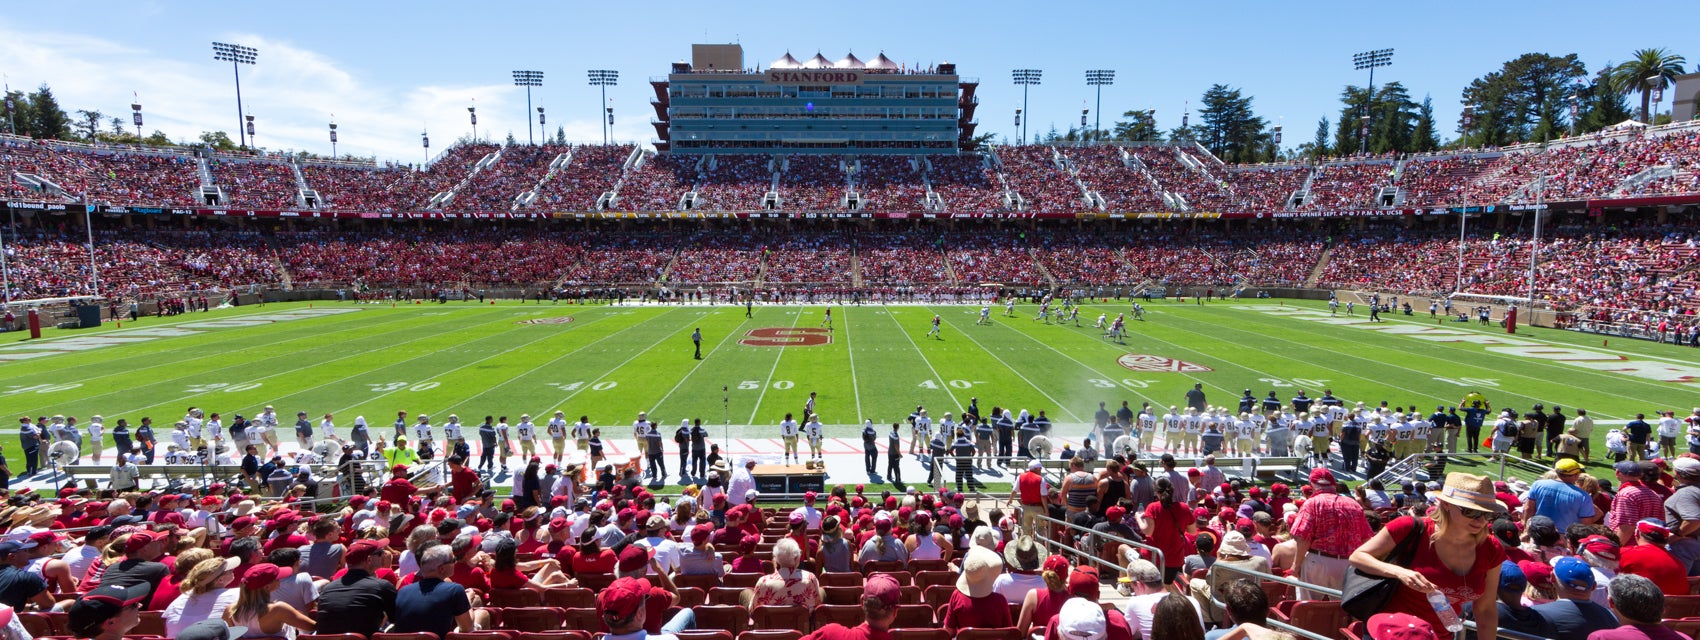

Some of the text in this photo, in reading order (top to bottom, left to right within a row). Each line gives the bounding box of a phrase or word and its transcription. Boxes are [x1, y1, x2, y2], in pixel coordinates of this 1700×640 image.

[771, 73, 857, 82] STANFORD
[737, 381, 795, 390] 50
[918, 379, 972, 389] 40
[1333, 411, 1344, 420] 13
[918, 422, 927, 431] 24
[1168, 419, 1178, 429] 48
[786, 426, 791, 434] 8
[812, 427, 817, 436] 5
[1241, 426, 1252, 435] 43
[165, 455, 176, 465] 50
